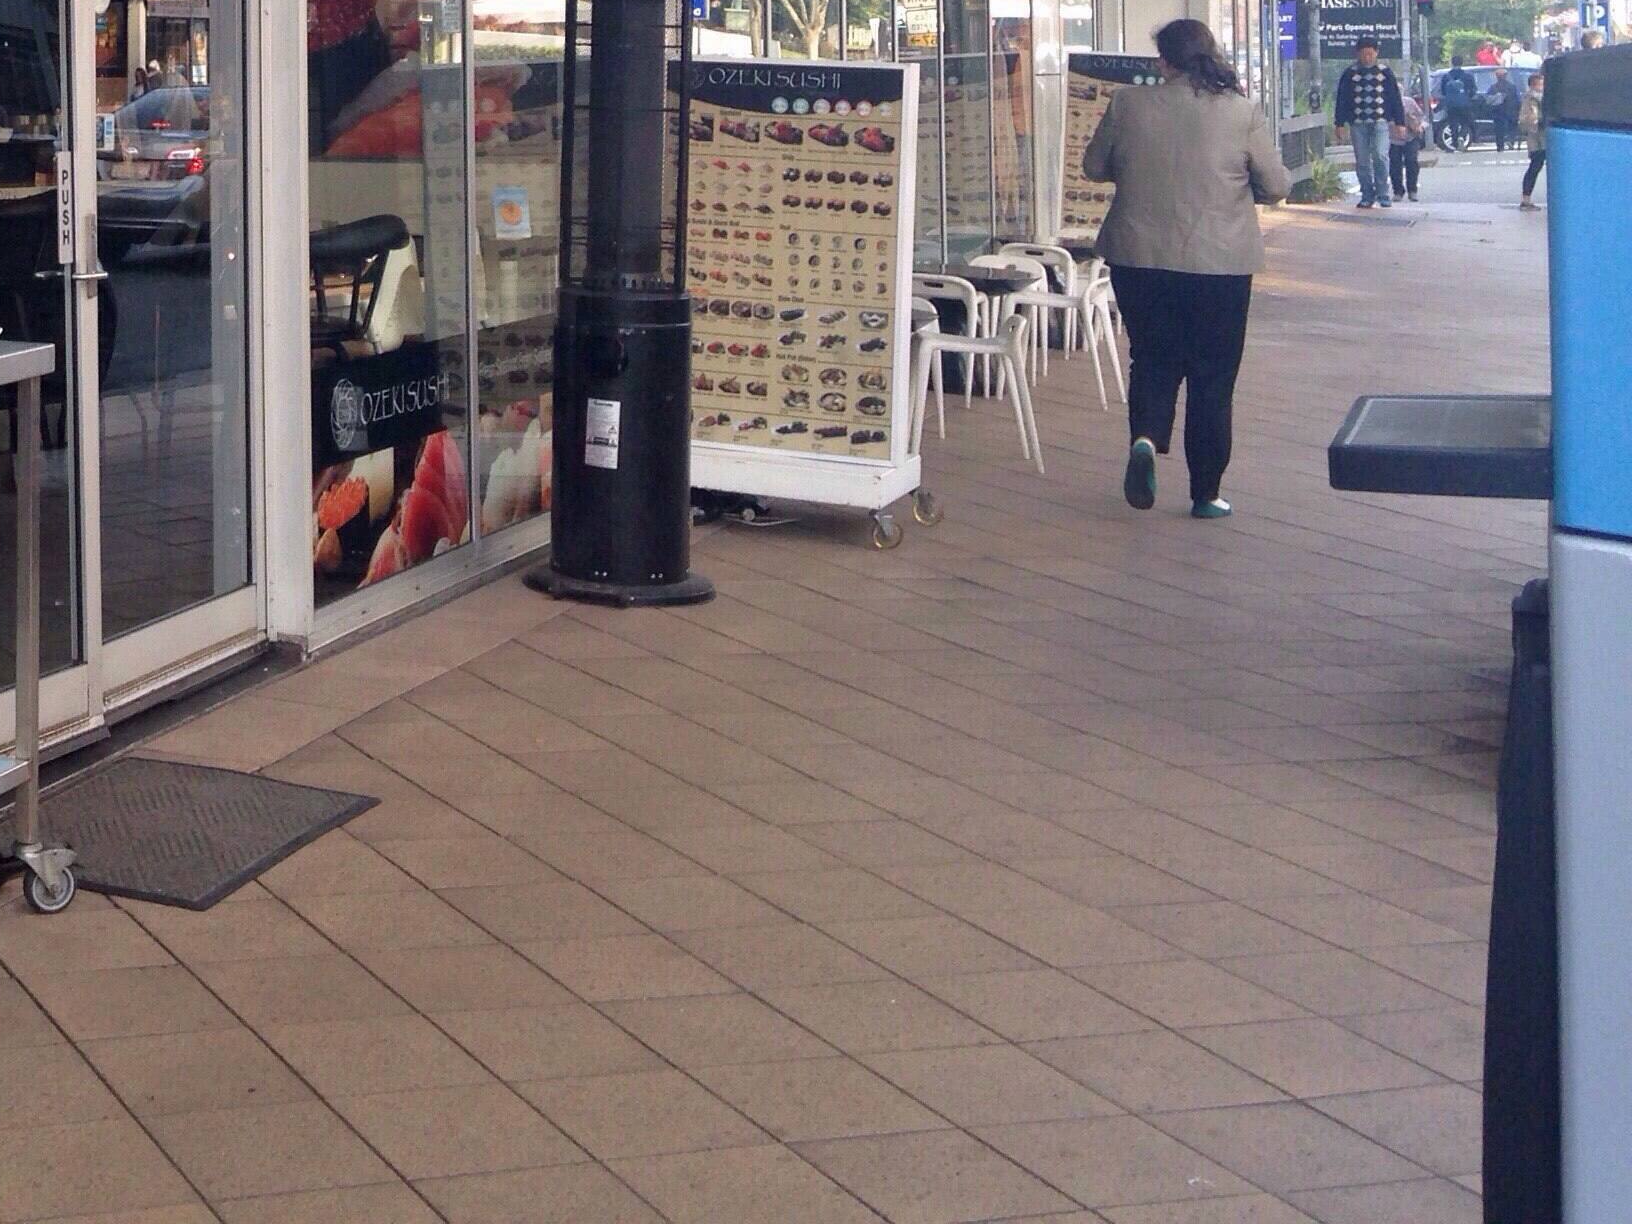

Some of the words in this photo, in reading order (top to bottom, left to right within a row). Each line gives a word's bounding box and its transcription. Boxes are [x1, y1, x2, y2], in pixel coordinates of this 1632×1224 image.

[61, 169, 70, 246] PUSH
[360, 383, 405, 425] OZEKI
[406, 372, 450, 413] SUSHI
